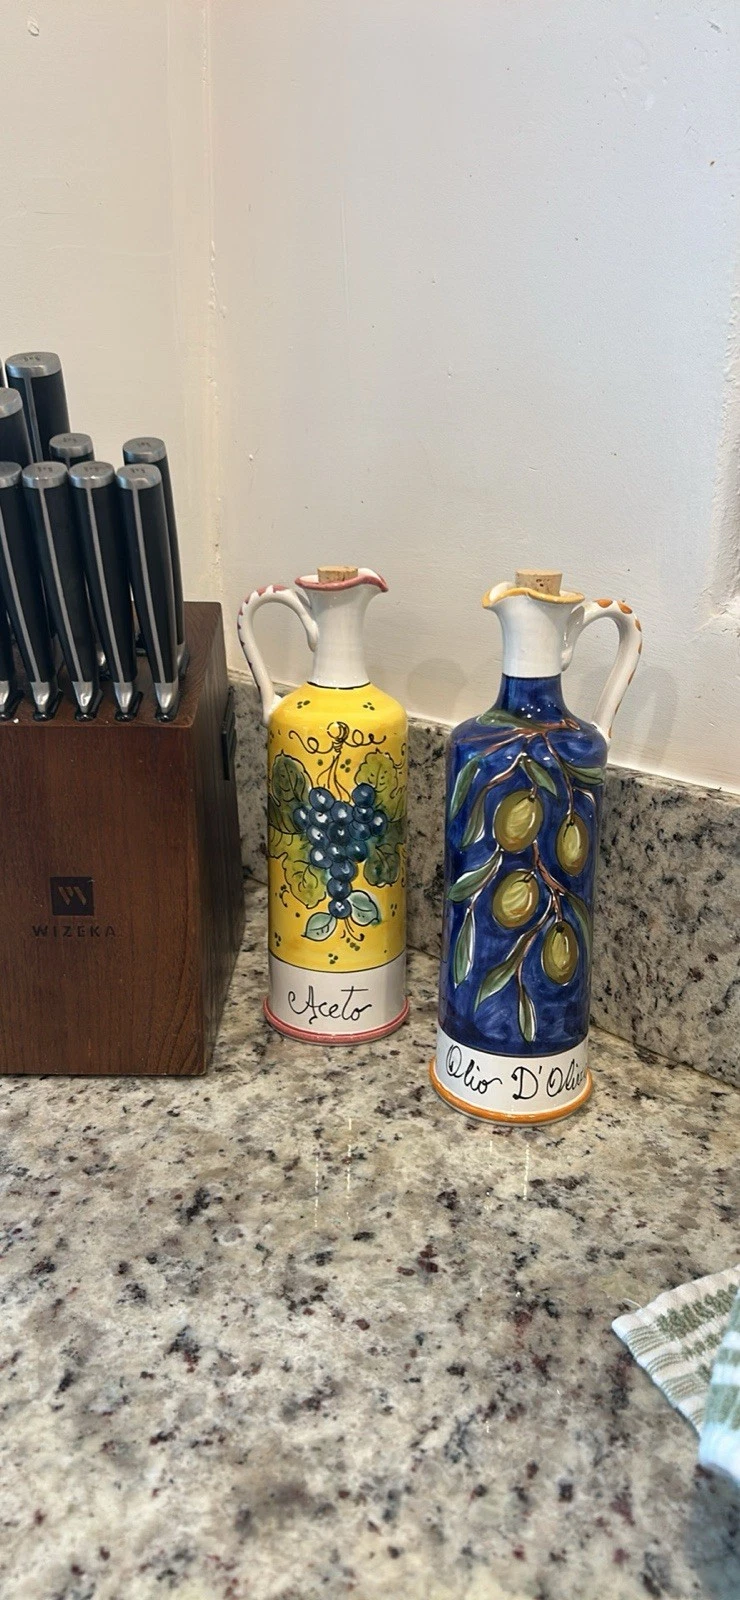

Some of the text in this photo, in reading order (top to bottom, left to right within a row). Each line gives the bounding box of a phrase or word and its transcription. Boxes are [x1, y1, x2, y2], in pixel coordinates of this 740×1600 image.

[32, 925, 116, 938] WIZEKA
[288, 985, 372, 1025] Aceto
[446, 1045, 503, 1094] Olio
